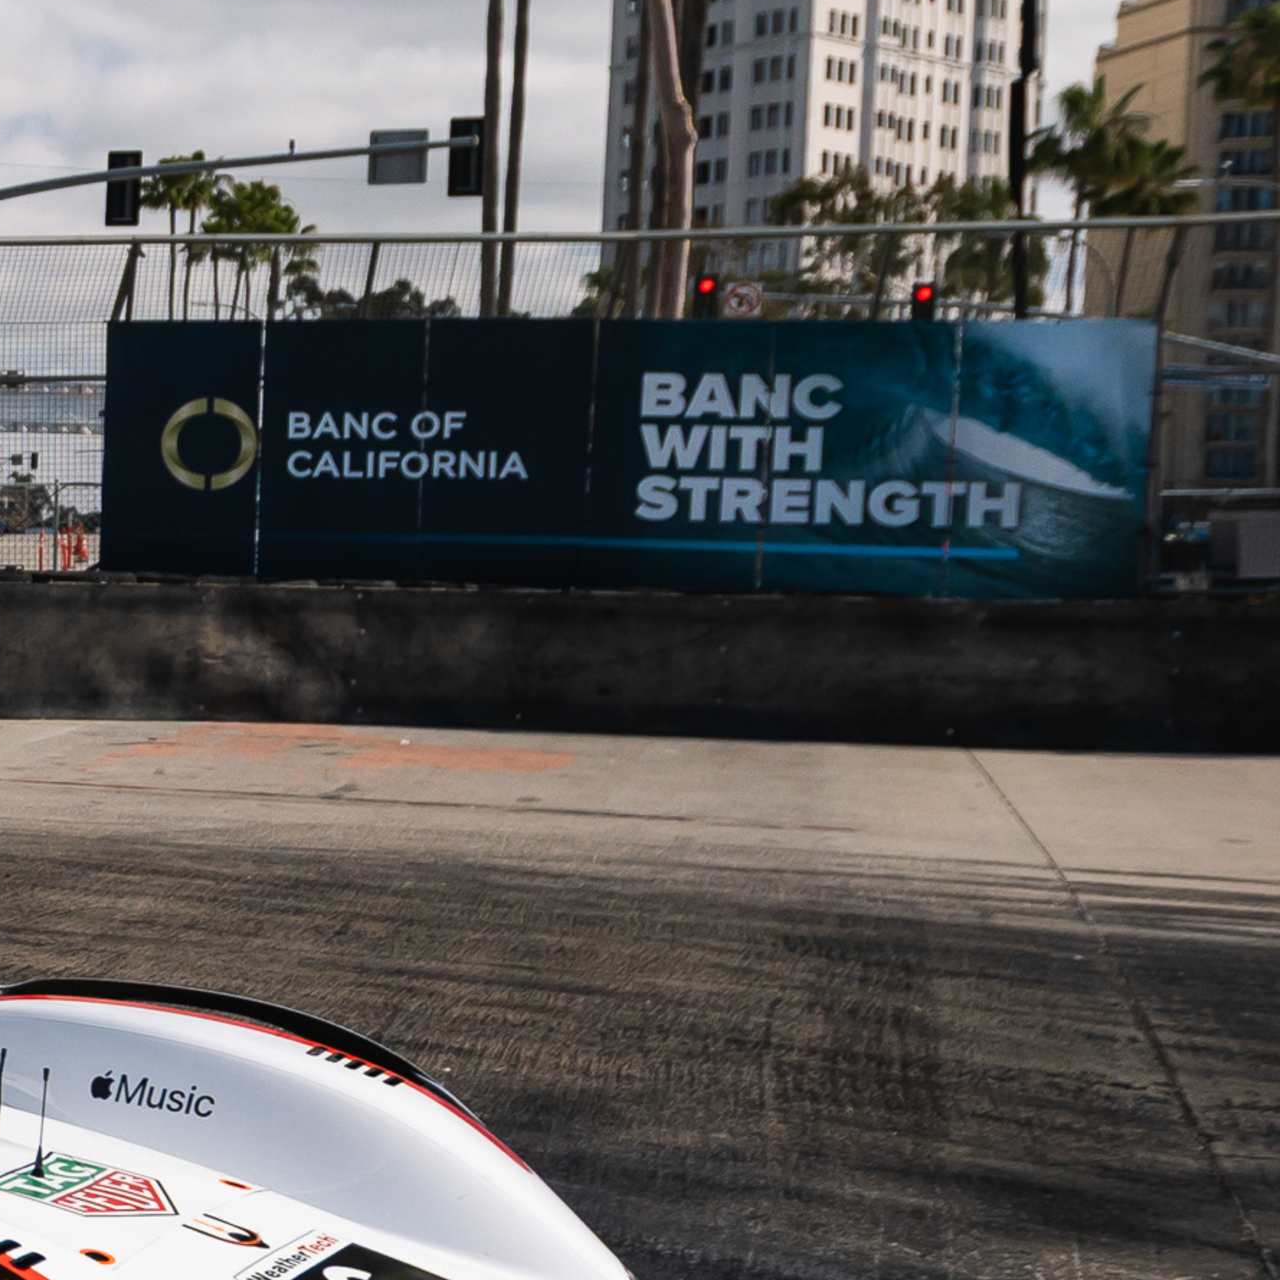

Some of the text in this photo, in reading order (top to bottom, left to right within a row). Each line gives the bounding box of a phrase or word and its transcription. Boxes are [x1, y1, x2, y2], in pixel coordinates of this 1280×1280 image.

[639, 371, 844, 422] BANC
[286, 410, 467, 442] BANC OF
[284, 448, 529, 481] CALIFORNIA
[640, 424, 824, 473] WITH
[635, 475, 1022, 529] STRENGTH
[114, 1073, 216, 1118] Music
[0, 1157, 97, 1199] TAG
[57, 1171, 162, 1213] HEUER
